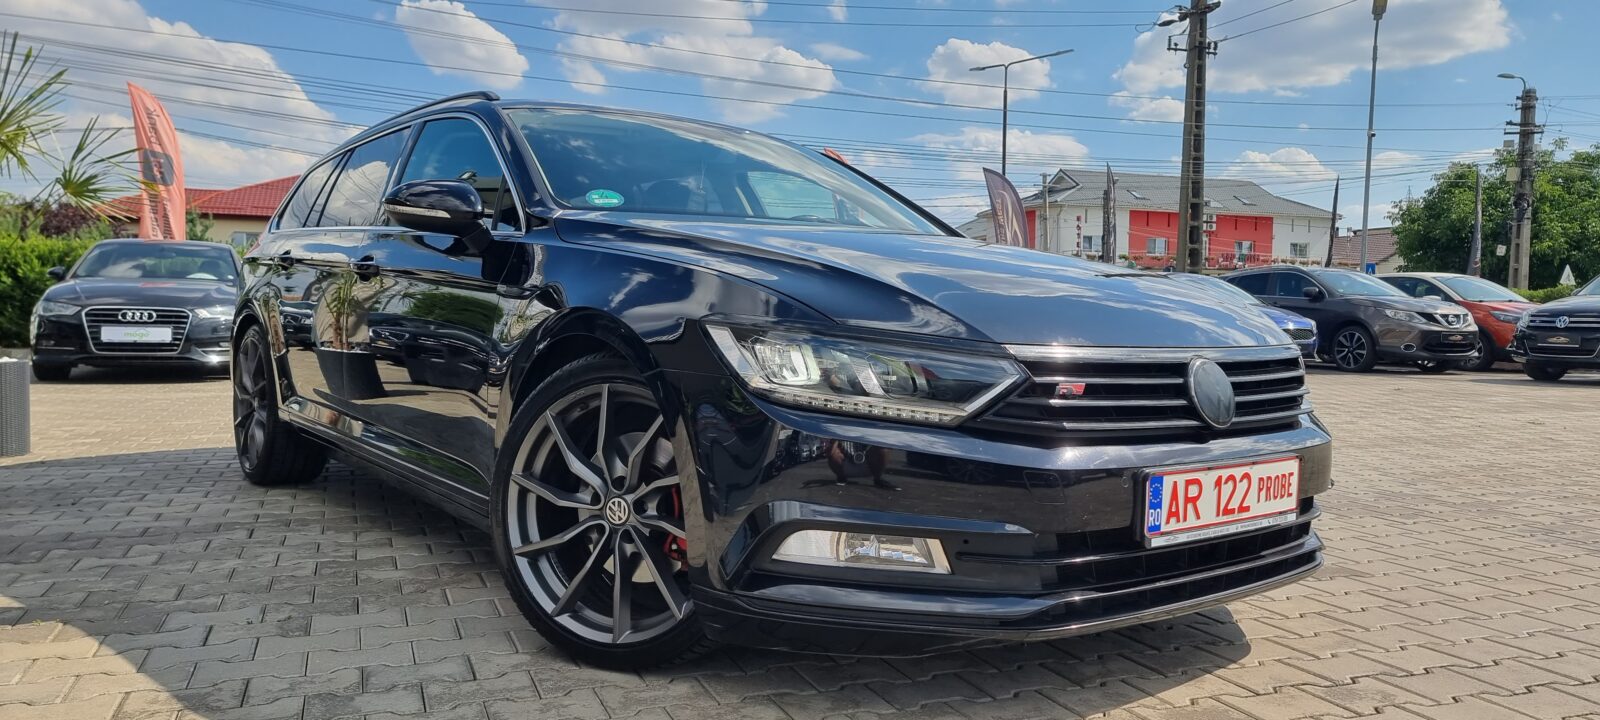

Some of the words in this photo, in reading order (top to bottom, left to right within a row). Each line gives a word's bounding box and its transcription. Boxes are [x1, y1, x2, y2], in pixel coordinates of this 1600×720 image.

[1165, 478, 1203, 524] AR
[1213, 472, 1252, 517] 122
[1257, 472, 1294, 503] PROBE
[1149, 509, 1161, 526] RO
